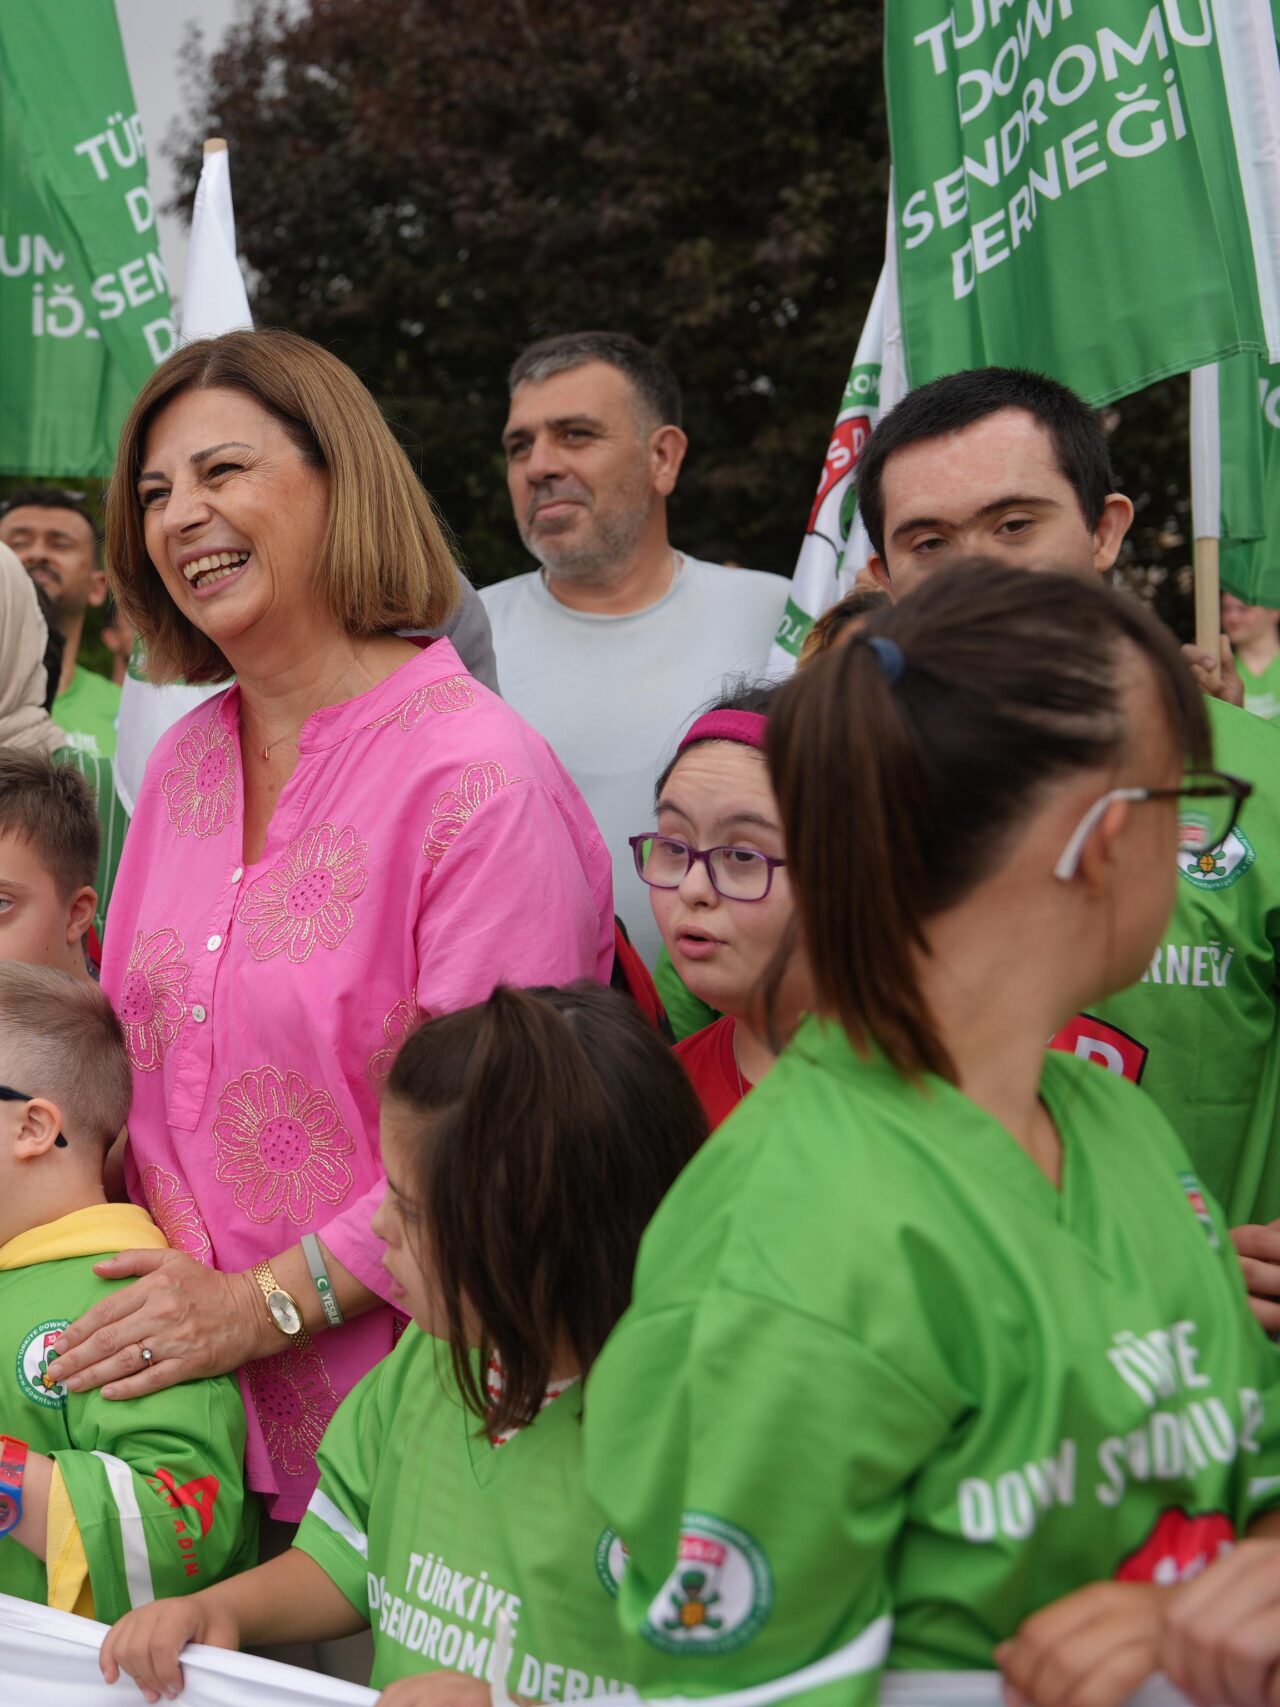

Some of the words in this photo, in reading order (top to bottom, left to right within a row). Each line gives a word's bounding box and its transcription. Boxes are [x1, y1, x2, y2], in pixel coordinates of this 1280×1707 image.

[902, 0, 1212, 249] SENDROMU
[957, 0, 1073, 130] DOW
[951, 68, 1187, 300] DERNEĞİ
[173, 1519, 200, 1577] ADIM
[405, 1552, 522, 1638] TÜRKİYE
